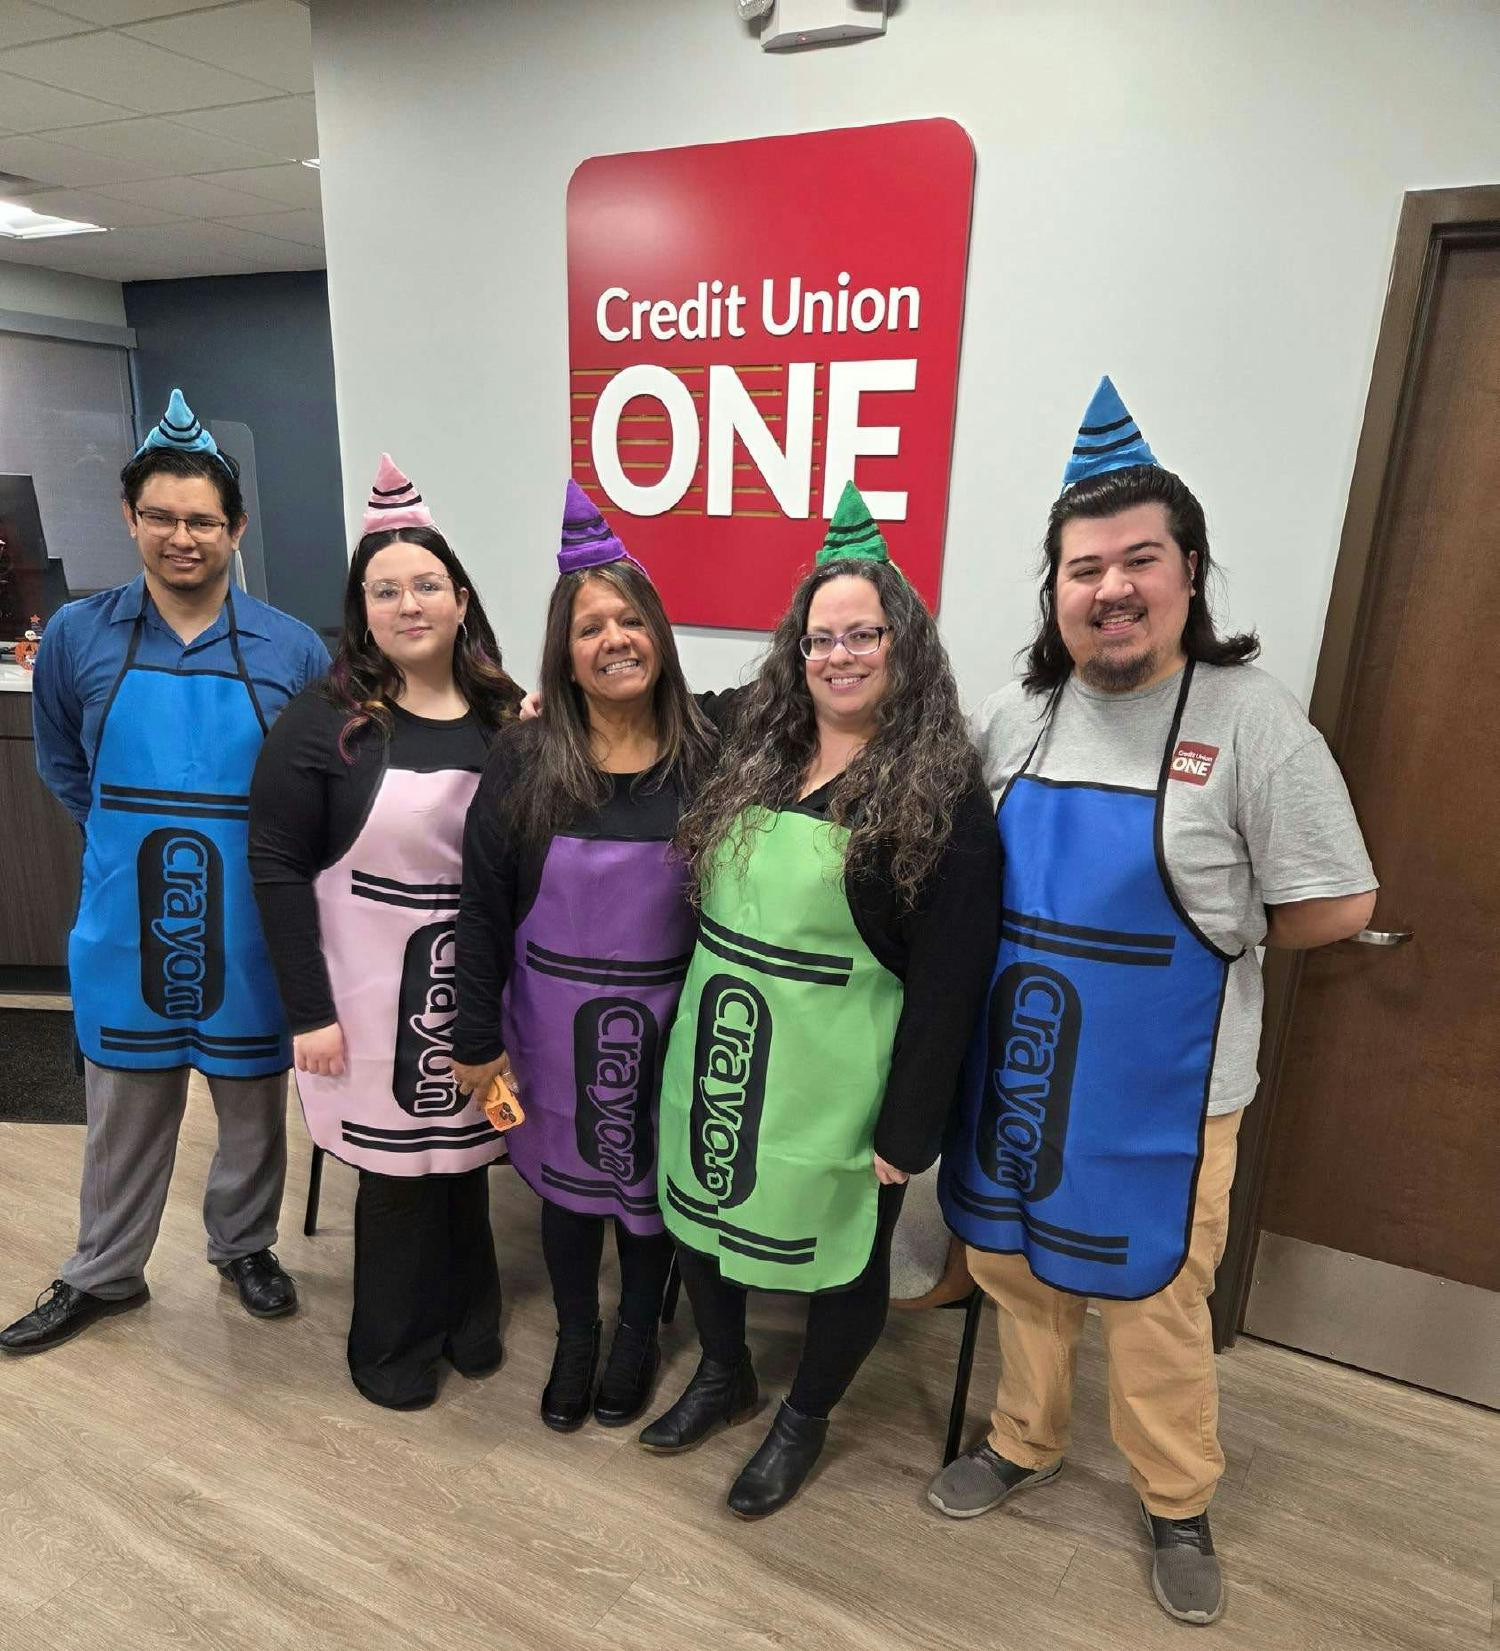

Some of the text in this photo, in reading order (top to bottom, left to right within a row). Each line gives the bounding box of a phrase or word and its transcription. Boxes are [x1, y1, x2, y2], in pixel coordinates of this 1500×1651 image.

[596, 271, 921, 342] Credit Union
[591, 358, 918, 521] ONE
[1172, 757, 1211, 776] ONE
